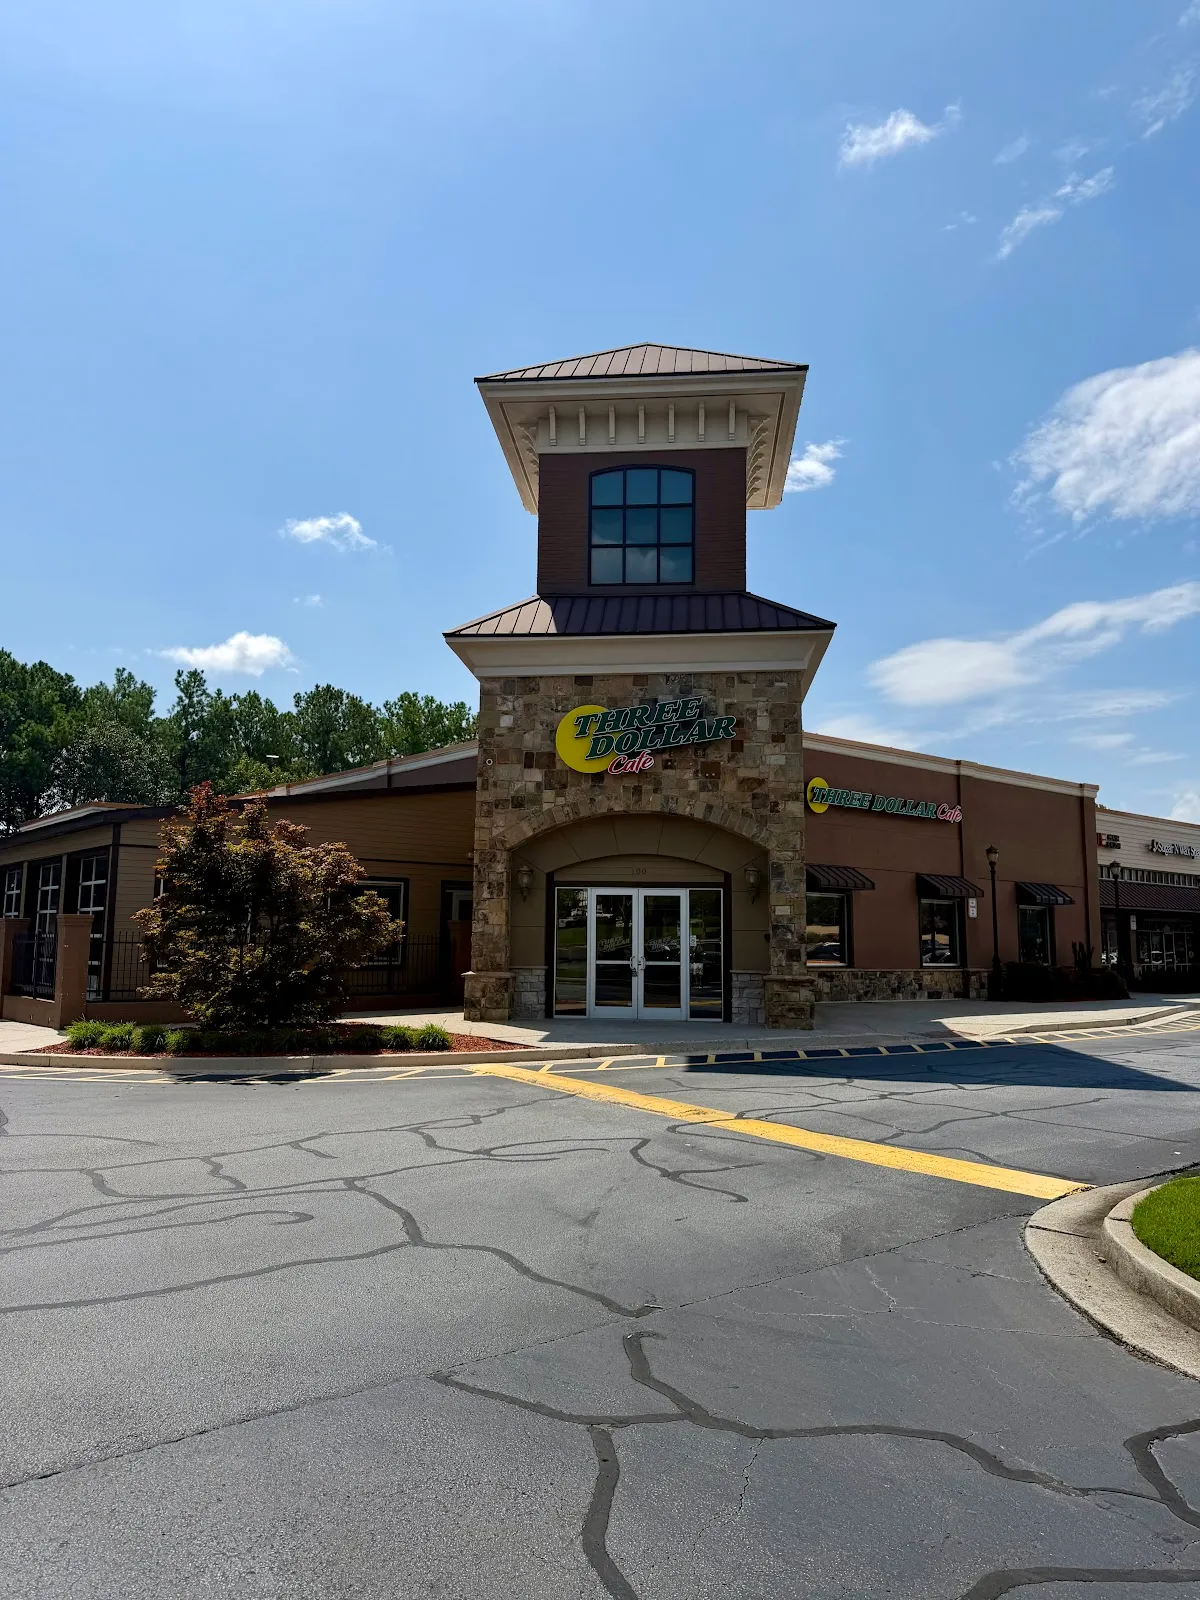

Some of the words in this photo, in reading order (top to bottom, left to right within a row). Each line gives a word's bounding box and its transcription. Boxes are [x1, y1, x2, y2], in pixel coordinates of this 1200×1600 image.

[574, 696, 703, 738] THREE
[585, 715, 737, 760] DOLLAR
[813, 786, 873, 809] THREE
[872, 794, 937, 819] DOLLAR
[631, 867, 647, 876] 100
